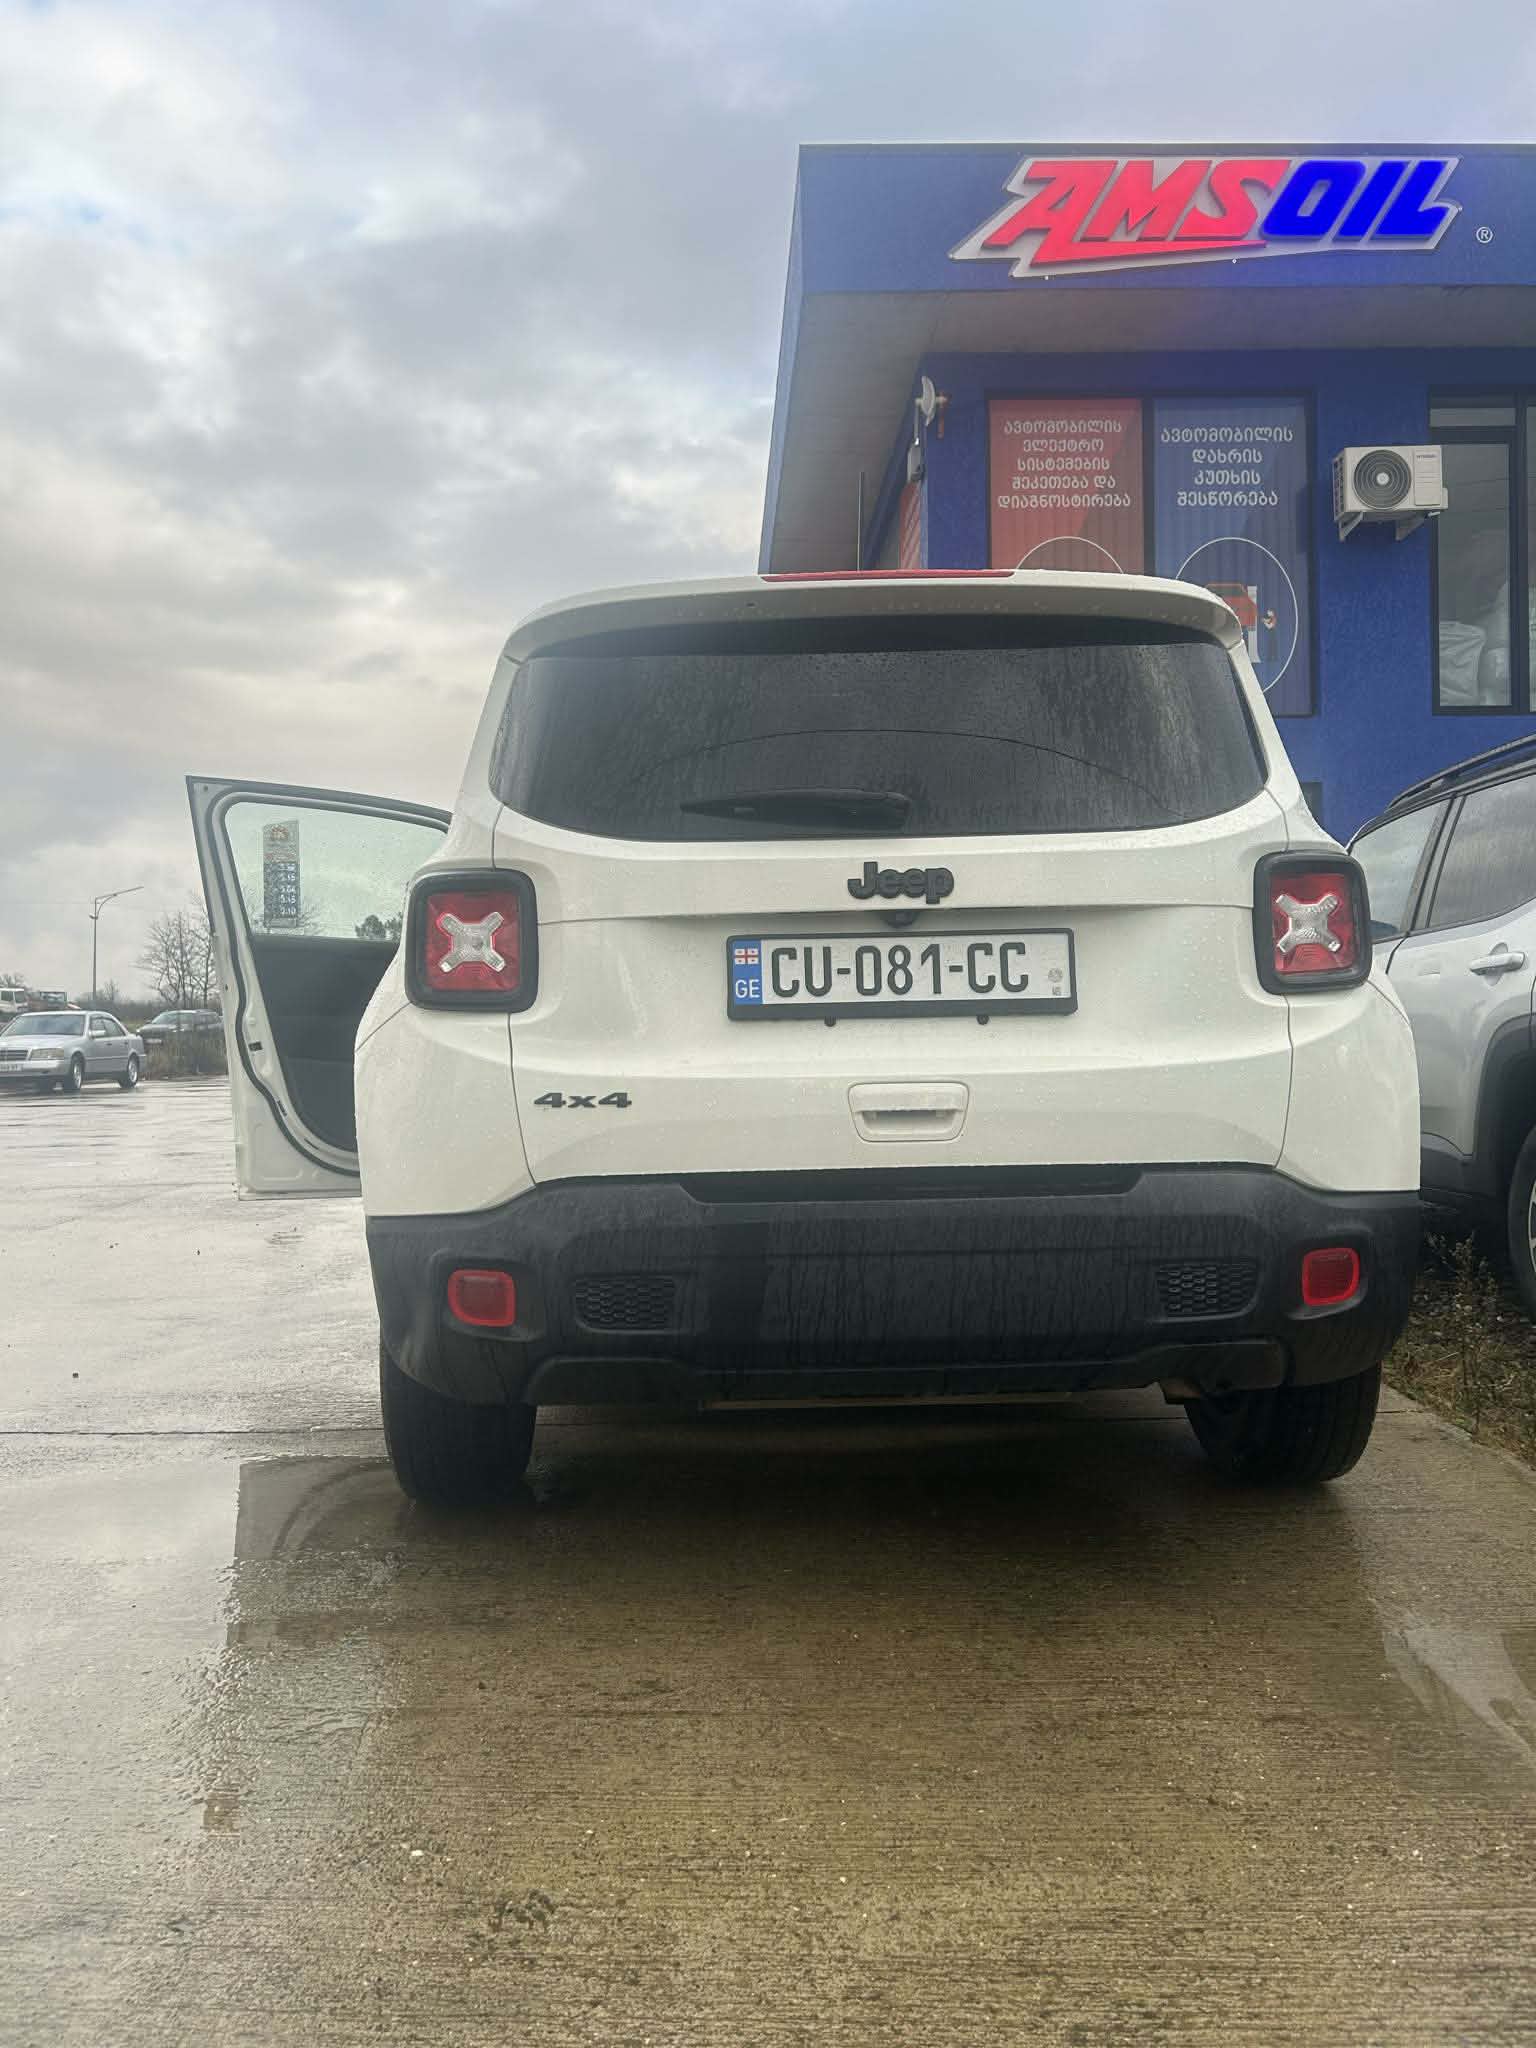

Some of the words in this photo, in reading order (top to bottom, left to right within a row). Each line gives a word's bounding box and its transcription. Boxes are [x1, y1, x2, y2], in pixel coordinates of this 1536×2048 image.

[977, 158, 1450, 267] AMSOIL
[1004, 419, 1122, 434] ავტომობილის
[1161, 426, 1293, 442] ავტომობილის
[1023, 438, 1104, 453] ელექტრო
[1017, 457, 1110, 471] სისტემების
[1191, 448, 1263, 464] დახრის
[1012, 475, 1089, 490] შეკეთება
[1093, 475, 1116, 489] და
[1194, 470, 1261, 485] კუთხის
[997, 493, 1131, 509] დიაგნოსტირება
[1177, 490, 1279, 507] შესწორება
[847, 861, 955, 904] Jeep
[771, 941, 1030, 998] CU-081-CC
[735, 979, 760, 999] GE
[533, 1092, 633, 1109] 4x4
